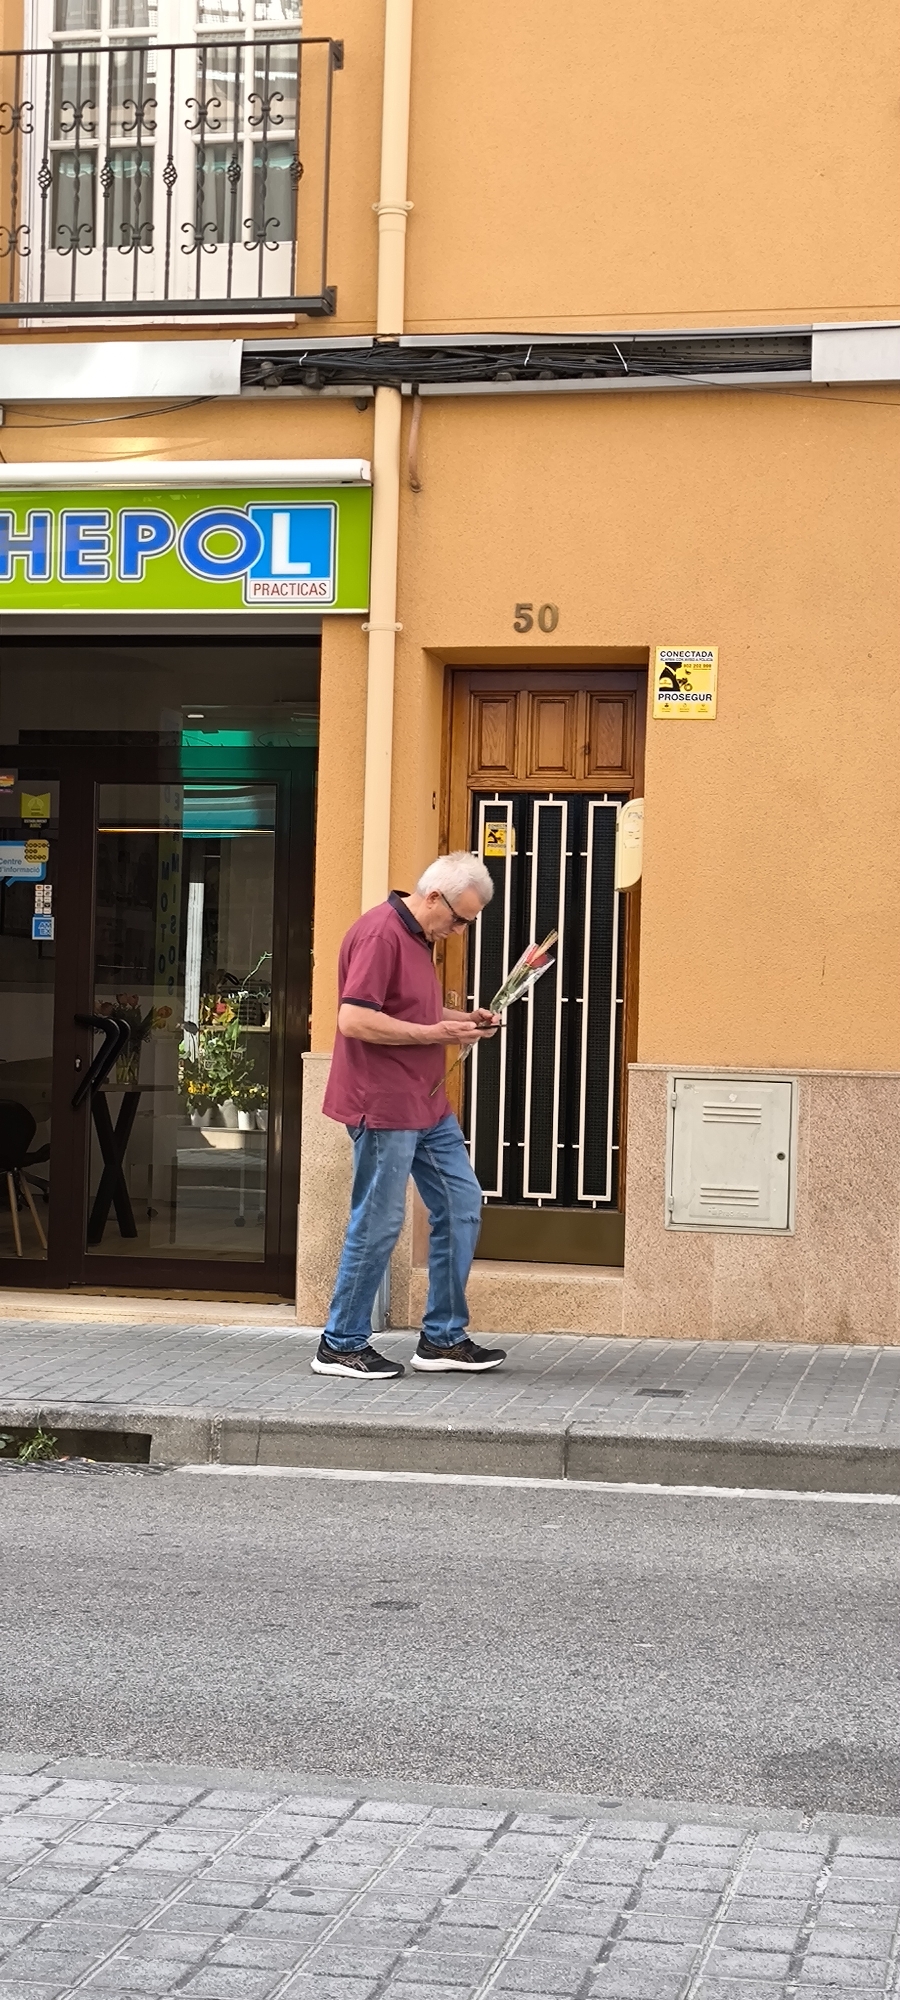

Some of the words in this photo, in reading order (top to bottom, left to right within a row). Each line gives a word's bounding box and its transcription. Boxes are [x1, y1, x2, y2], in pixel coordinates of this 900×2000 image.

[253, 582, 327, 597] PRACTICAS
[513, 603, 559, 633] 50
[660, 650, 713, 658] CONECTADA
[658, 693, 712, 701] PROSEGUR
